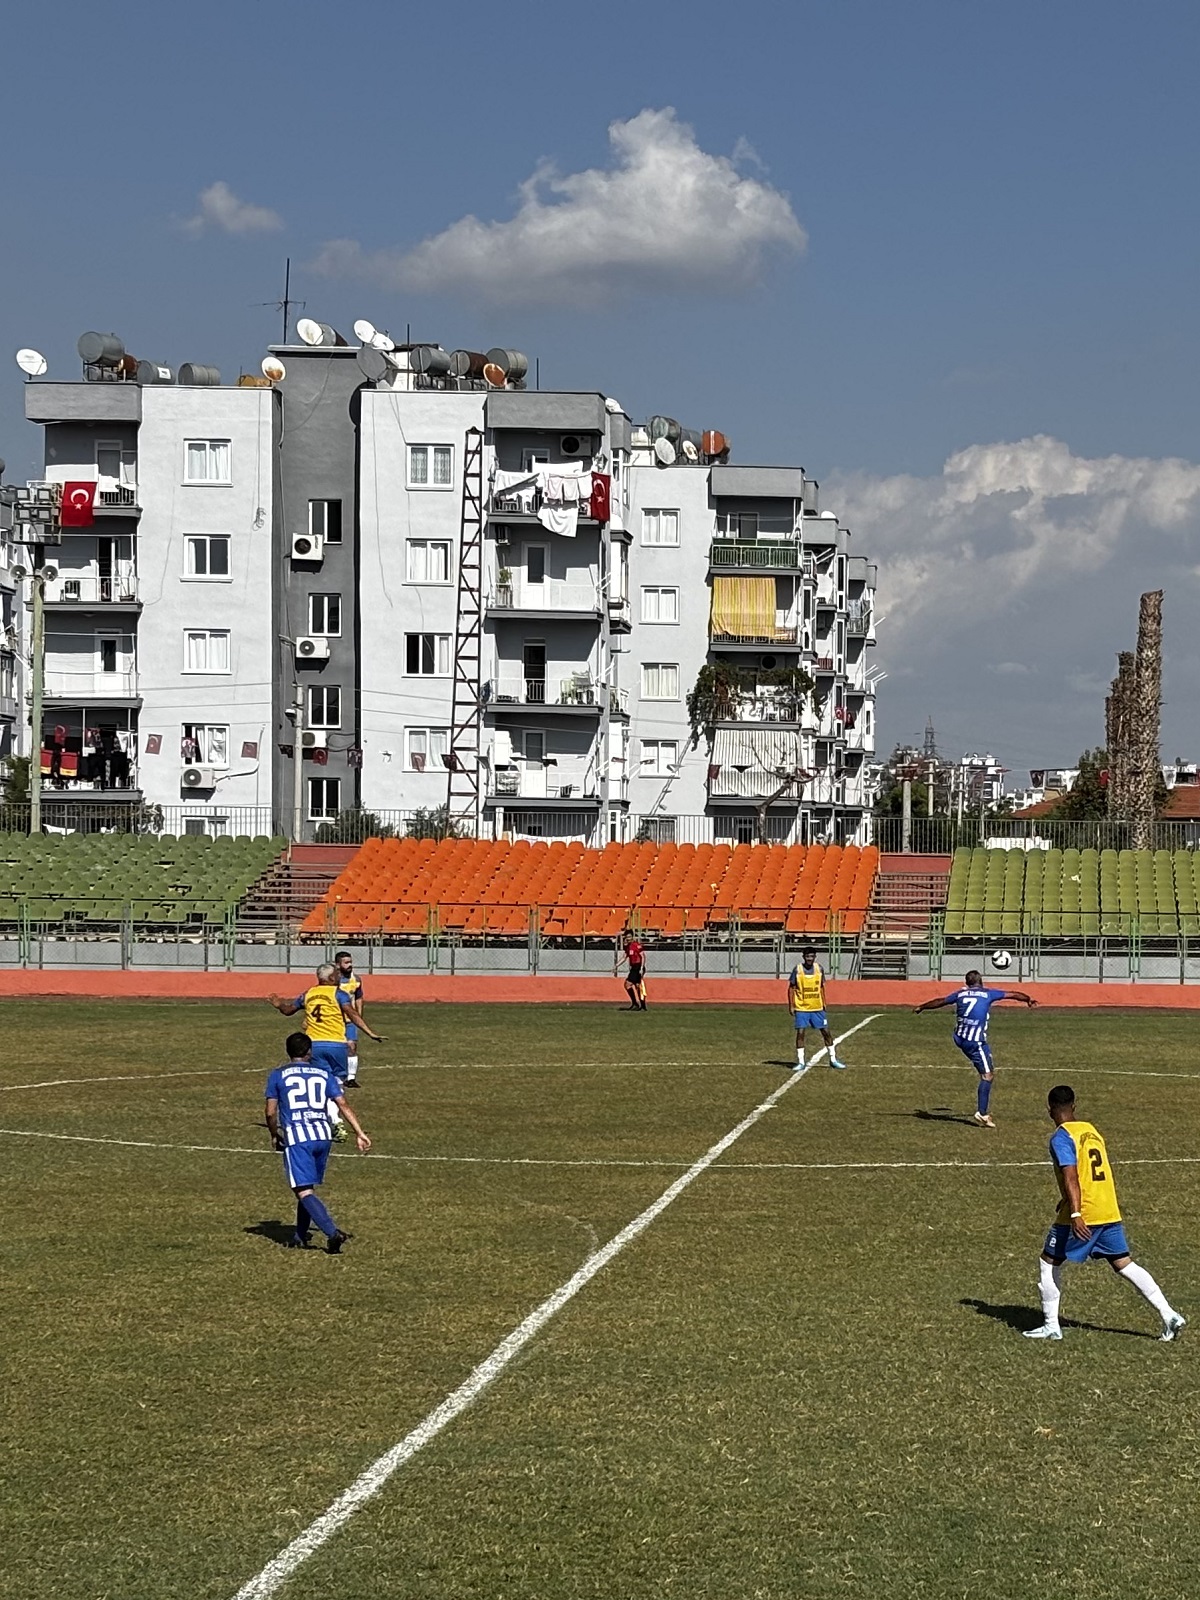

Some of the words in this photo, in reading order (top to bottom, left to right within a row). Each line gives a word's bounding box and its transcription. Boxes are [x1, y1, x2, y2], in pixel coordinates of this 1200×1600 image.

[311, 1004, 323, 1023] 4
[963, 997, 978, 1017] 7
[285, 1076, 327, 1110] 20
[1088, 1148, 1106, 1181] 2
[1049, 1237, 1057, 1248] 2
